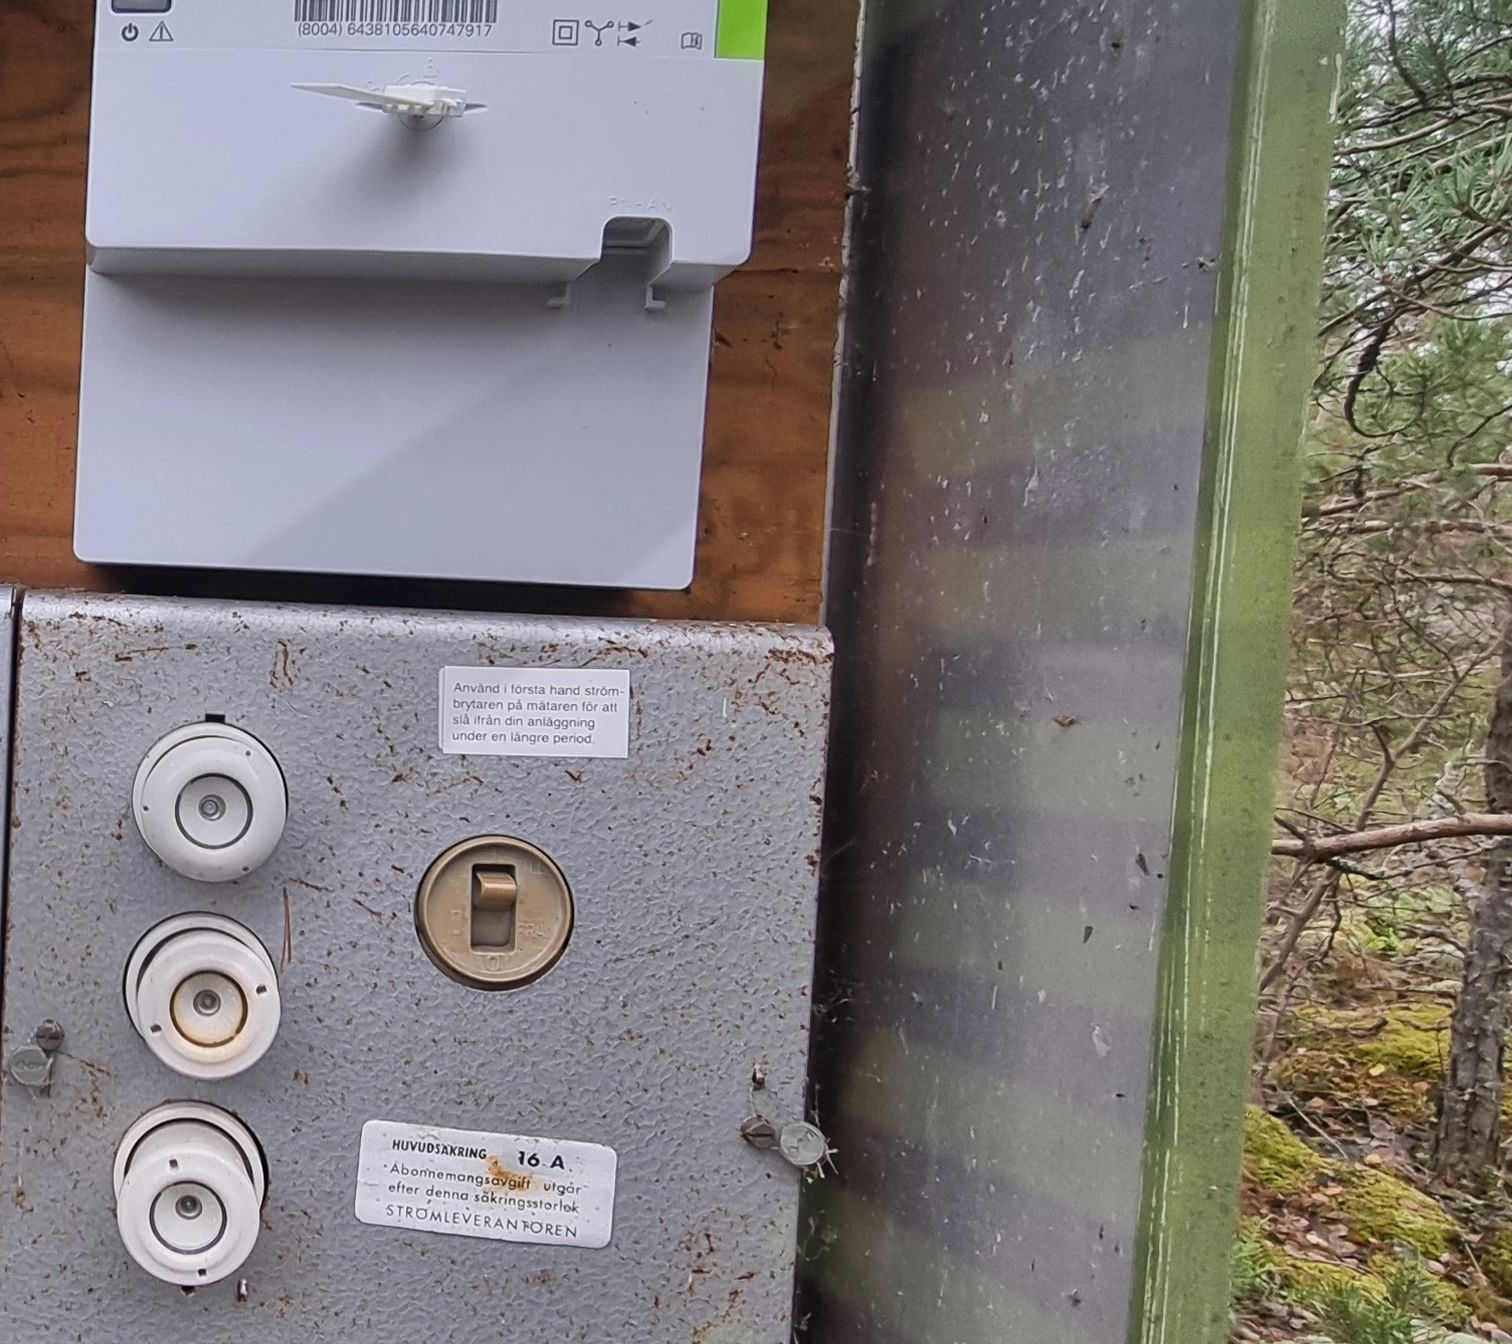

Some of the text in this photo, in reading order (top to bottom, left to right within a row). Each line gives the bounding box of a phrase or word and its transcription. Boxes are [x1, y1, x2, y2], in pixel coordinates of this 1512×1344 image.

[298, 22, 343, 38] (8004)
[453, 682, 624, 697] Använd första hand ström-
[453, 699, 618, 713] brytaren på mätaren för att
[452, 713, 595, 730] slå ifrån din anläggning
[452, 730, 487, 741] under
[491, 733, 506, 741] en
[511, 731, 550, 744] längre
[392, 1139, 565, 1170] HUVUDSÄKRING 16 A
[390, 1163, 582, 1197] Abonnemangsavgift utgår
[388, 1182, 580, 1214] efter denna säkringsstorlek
[386, 1204, 577, 1238] STRÖMLEVERANTÖREN
